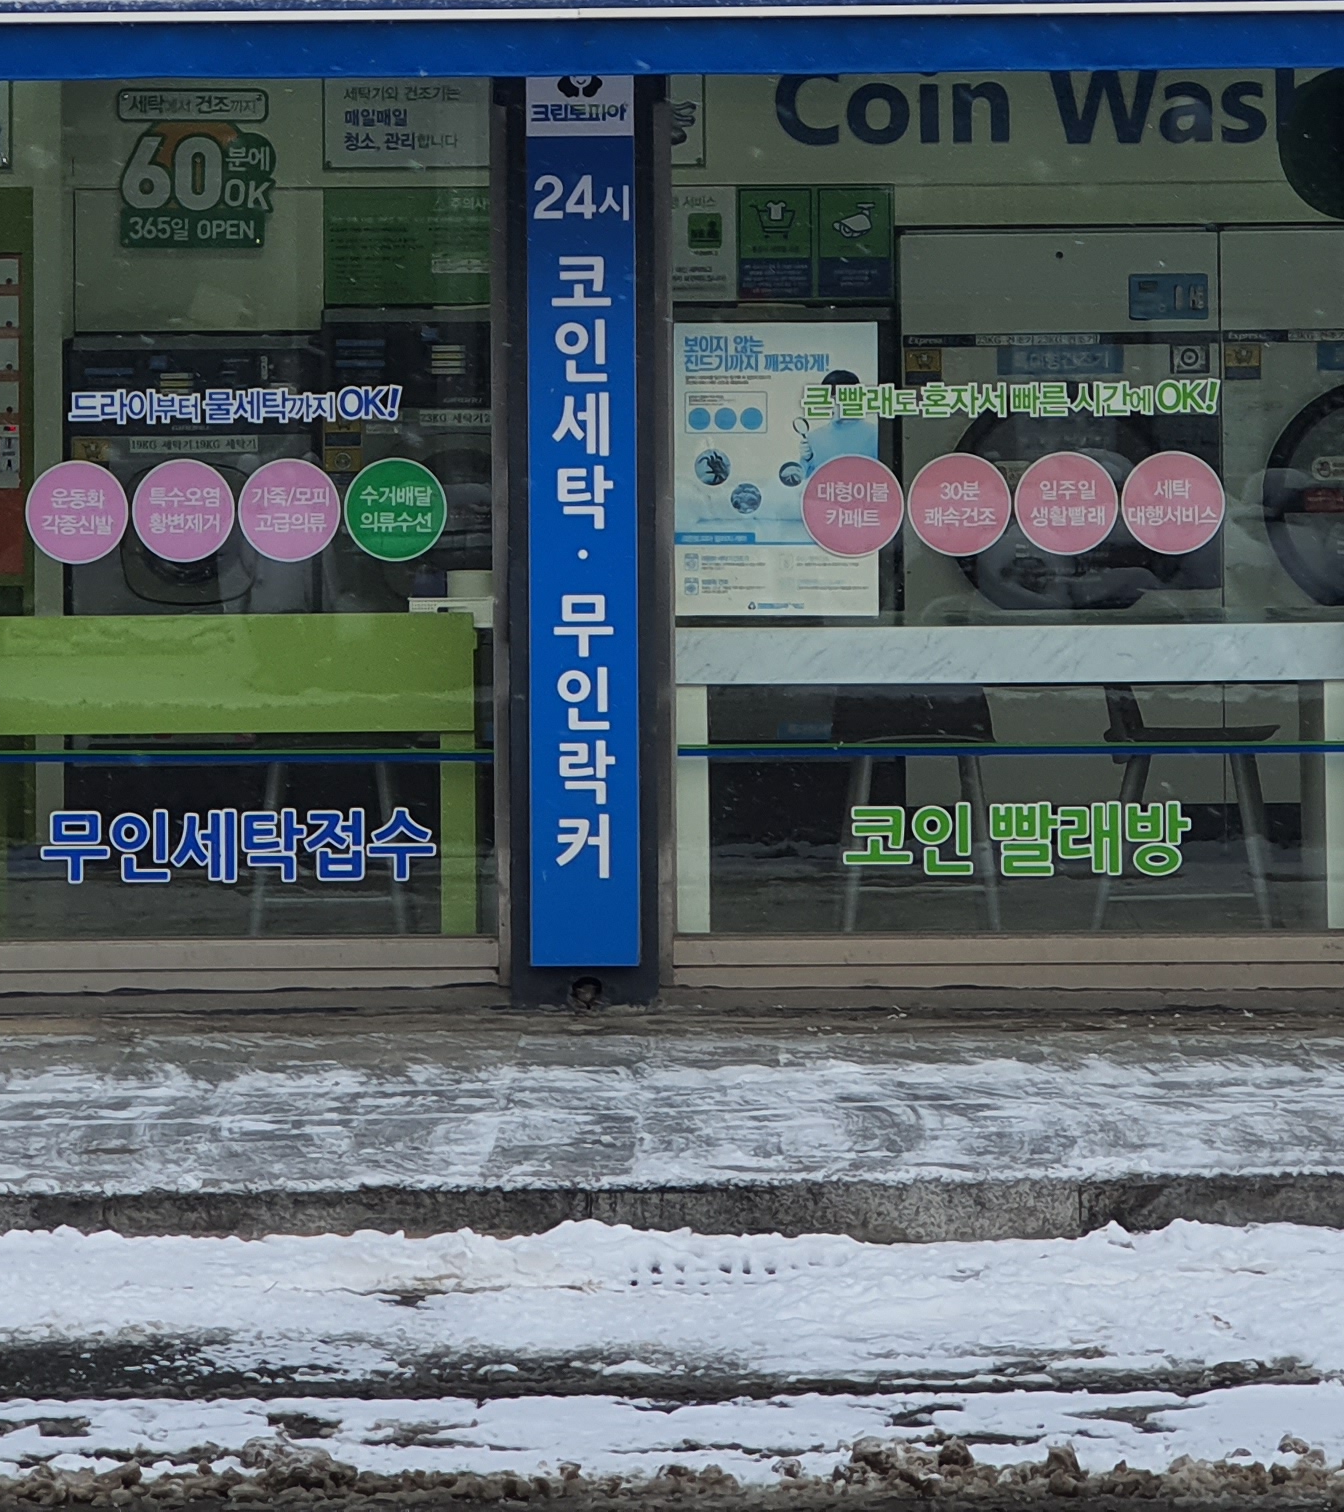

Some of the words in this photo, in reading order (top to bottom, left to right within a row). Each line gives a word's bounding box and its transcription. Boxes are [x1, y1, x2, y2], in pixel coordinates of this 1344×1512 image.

[344, 108, 408, 127] 매일매일
[531, 103, 627, 121] 크린토피아
[775, 72, 1010, 145] Coin
[344, 132, 380, 151] 청소,
[384, 132, 458, 150] 관리합니다
[225, 179, 272, 210] OK
[533, 175, 630, 221] 24시
[129, 216, 189, 241] 365일
[197, 220, 255, 239] OPEN
[684, 336, 728, 354] 보이지
[733, 335, 764, 354] 않는
[684, 353, 759, 373] 진드기까지
[764, 353, 829, 372] 깨끗하게!
[69, 390, 201, 425] 드라이부터
[204, 388, 336, 424] 물세탁까지
[337, 385, 402, 422] OK!
[802, 384, 834, 418] 큰
[837, 383, 918, 418] 빨래도
[921, 382, 1007, 419] 혼자서
[1011, 382, 1070, 418] 빠른
[1073, 382, 1154, 418] 시간에
[1155, 378, 1222, 416] OK!
[50, 488, 105, 509] 운동화
[149, 487, 221, 508] 특수오염
[251, 486, 330, 508] 가죽/모피
[359, 486, 433, 508] 수거배달
[817, 481, 889, 502] 대형이불
[940, 480, 980, 501] 30분
[1039, 480, 1096, 501] 일주일
[1153, 480, 1192, 500] 세탁
[41, 513, 114, 536] 각종신발
[148, 513, 220, 535] 황변제거
[254, 512, 326, 534] 고급의류
[359, 511, 433, 534] 의류수선
[825, 508, 881, 529] 카페트
[923, 506, 997, 528] 쾌속건조
[1030, 506, 1106, 528] 생활빨래
[1127, 505, 1218, 527] 대행서비스
[41, 808, 436, 883] 무인세탁접수
[843, 801, 973, 876] 코인
[989, 801, 1191, 876] 빨래방
